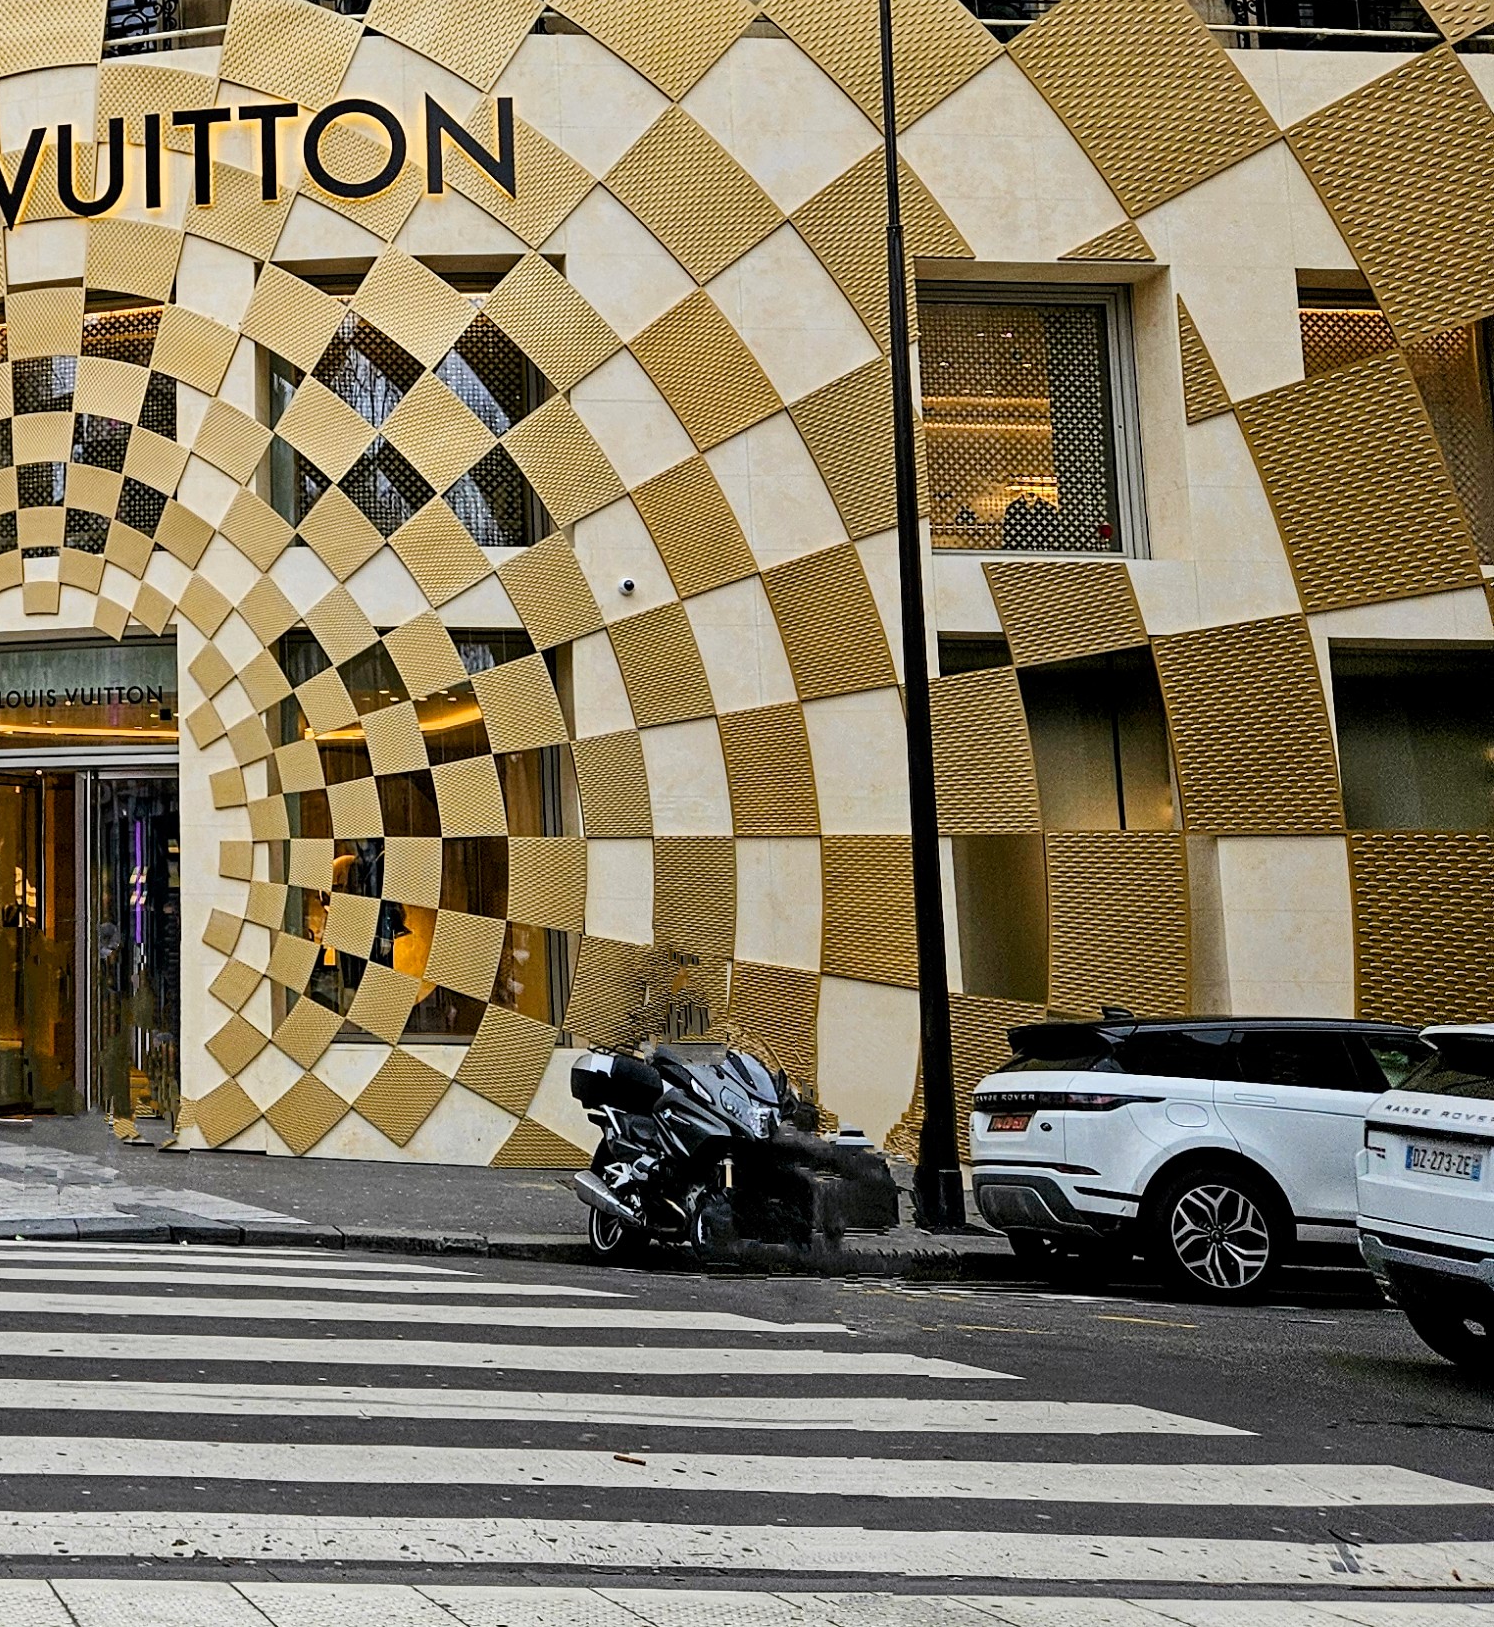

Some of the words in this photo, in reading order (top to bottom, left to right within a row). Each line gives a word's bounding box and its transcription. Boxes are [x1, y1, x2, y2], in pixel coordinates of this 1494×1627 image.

[65, 685, 163, 706] VUITTON
[1001, 1094, 1035, 1102] ROVER
[1385, 1104, 1431, 1116] RANGE
[1412, 1148, 1472, 1176] DZ-273-ZE
